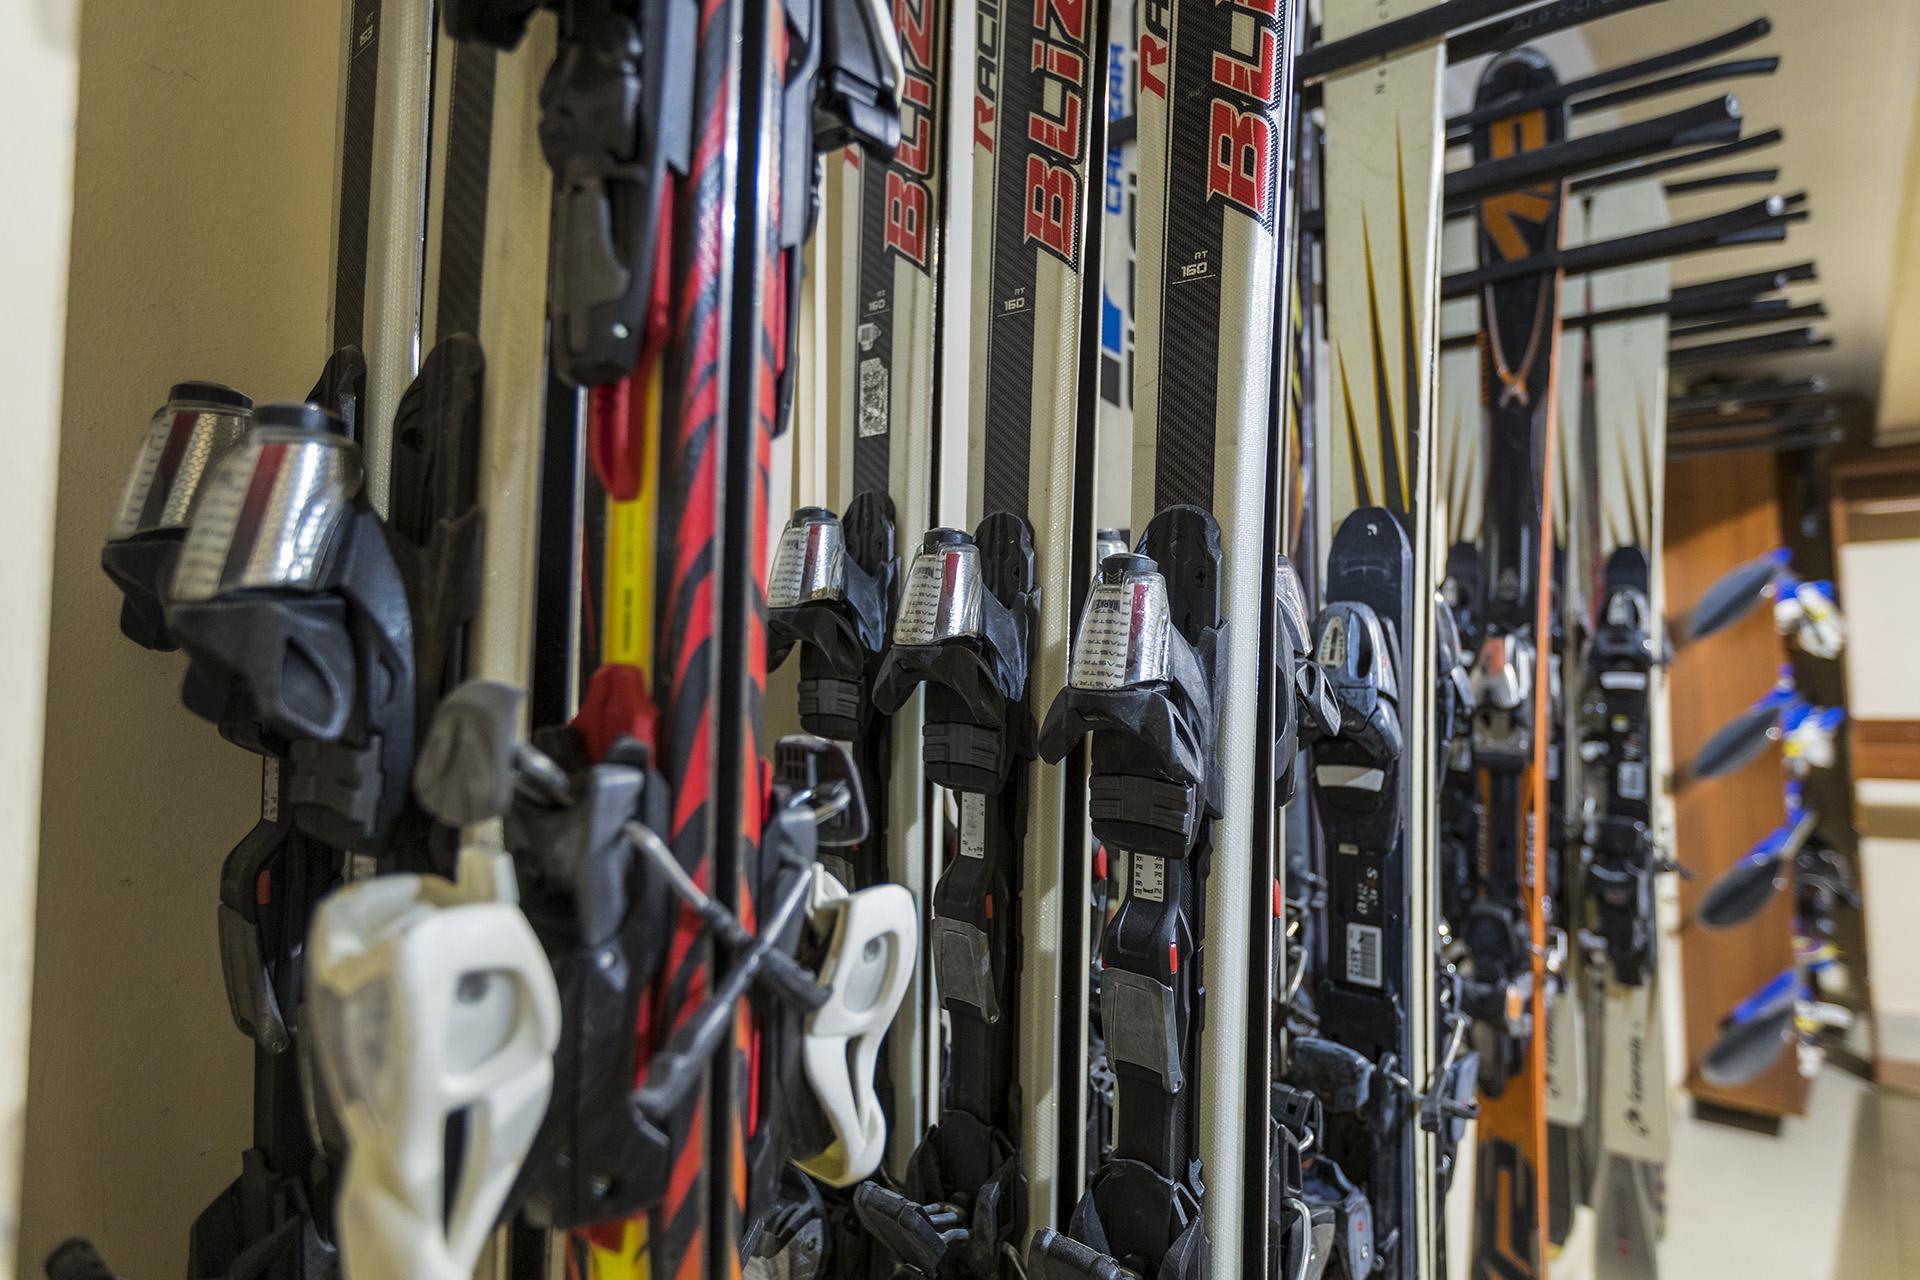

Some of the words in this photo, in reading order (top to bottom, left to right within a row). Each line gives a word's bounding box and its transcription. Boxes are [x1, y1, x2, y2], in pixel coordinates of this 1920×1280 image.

[974, 0, 1000, 154] RACI
[1181, 261, 1208, 278] 160
[1004, 297, 1026, 311] 160
